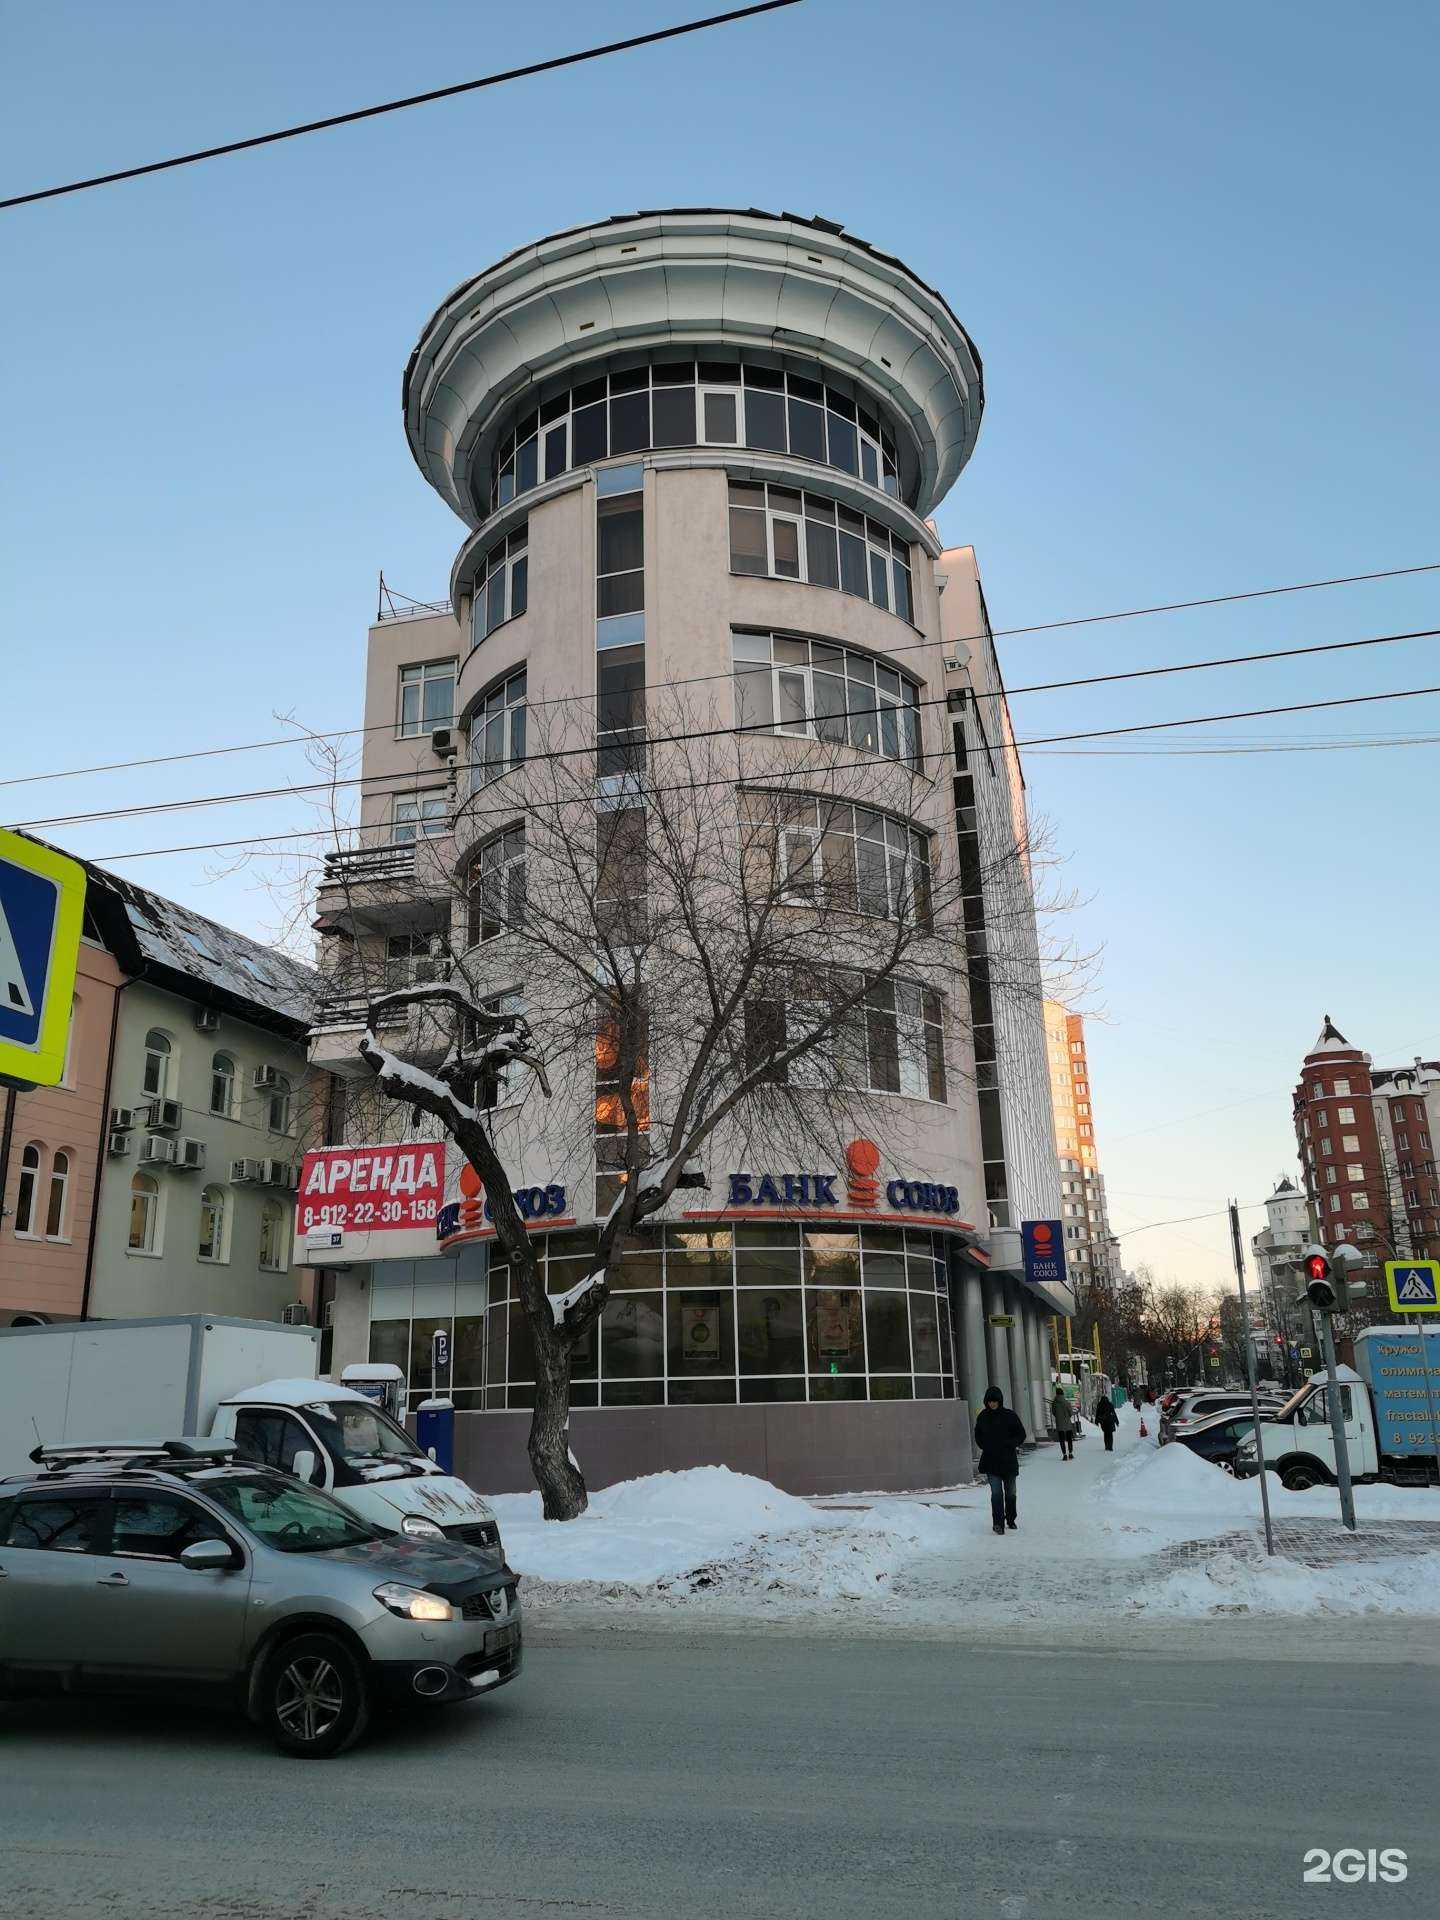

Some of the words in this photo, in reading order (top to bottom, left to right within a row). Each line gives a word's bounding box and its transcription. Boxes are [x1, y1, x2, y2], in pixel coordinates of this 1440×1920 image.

[305, 1153, 438, 1195] АРЕНДА
[728, 1173, 839, 1206] БАНК
[886, 1179, 960, 1214] СОЮЗ
[303, 1199, 437, 1227] 8-912-22-30-158
[1033, 1262, 1057, 1270] БАНК
